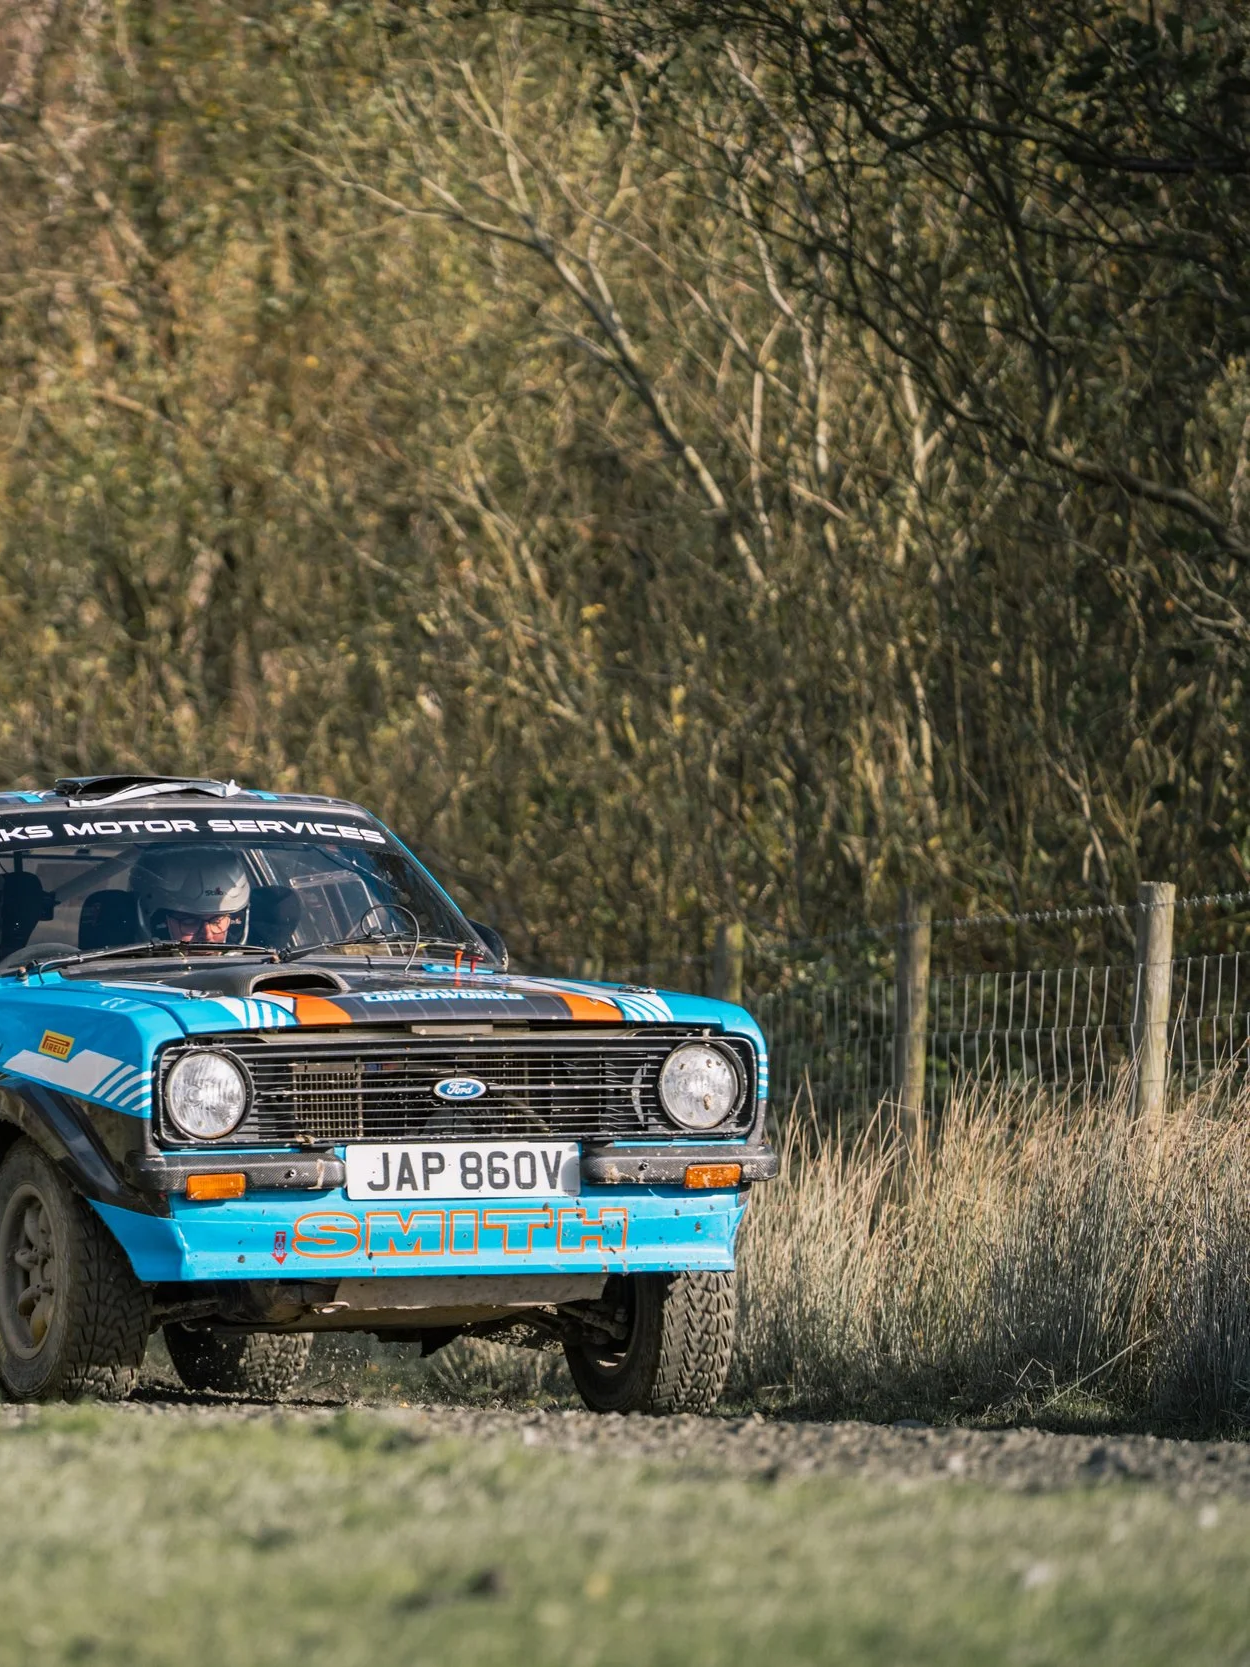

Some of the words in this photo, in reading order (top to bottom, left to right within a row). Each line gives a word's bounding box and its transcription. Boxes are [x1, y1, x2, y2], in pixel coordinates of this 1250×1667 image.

[63, 820, 199, 836] MOTOR
[207, 820, 386, 844] SERVICES
[362, 992, 525, 1002] COACHWORKS
[42, 1034, 71, 1056] PIRELLI
[446, 1081, 475, 1096] Ford
[367, 1151, 445, 1191] JAP
[459, 1151, 562, 1190] 860V
[274, 1233, 286, 1257] TOW
[292, 1208, 628, 1258] SMITH
